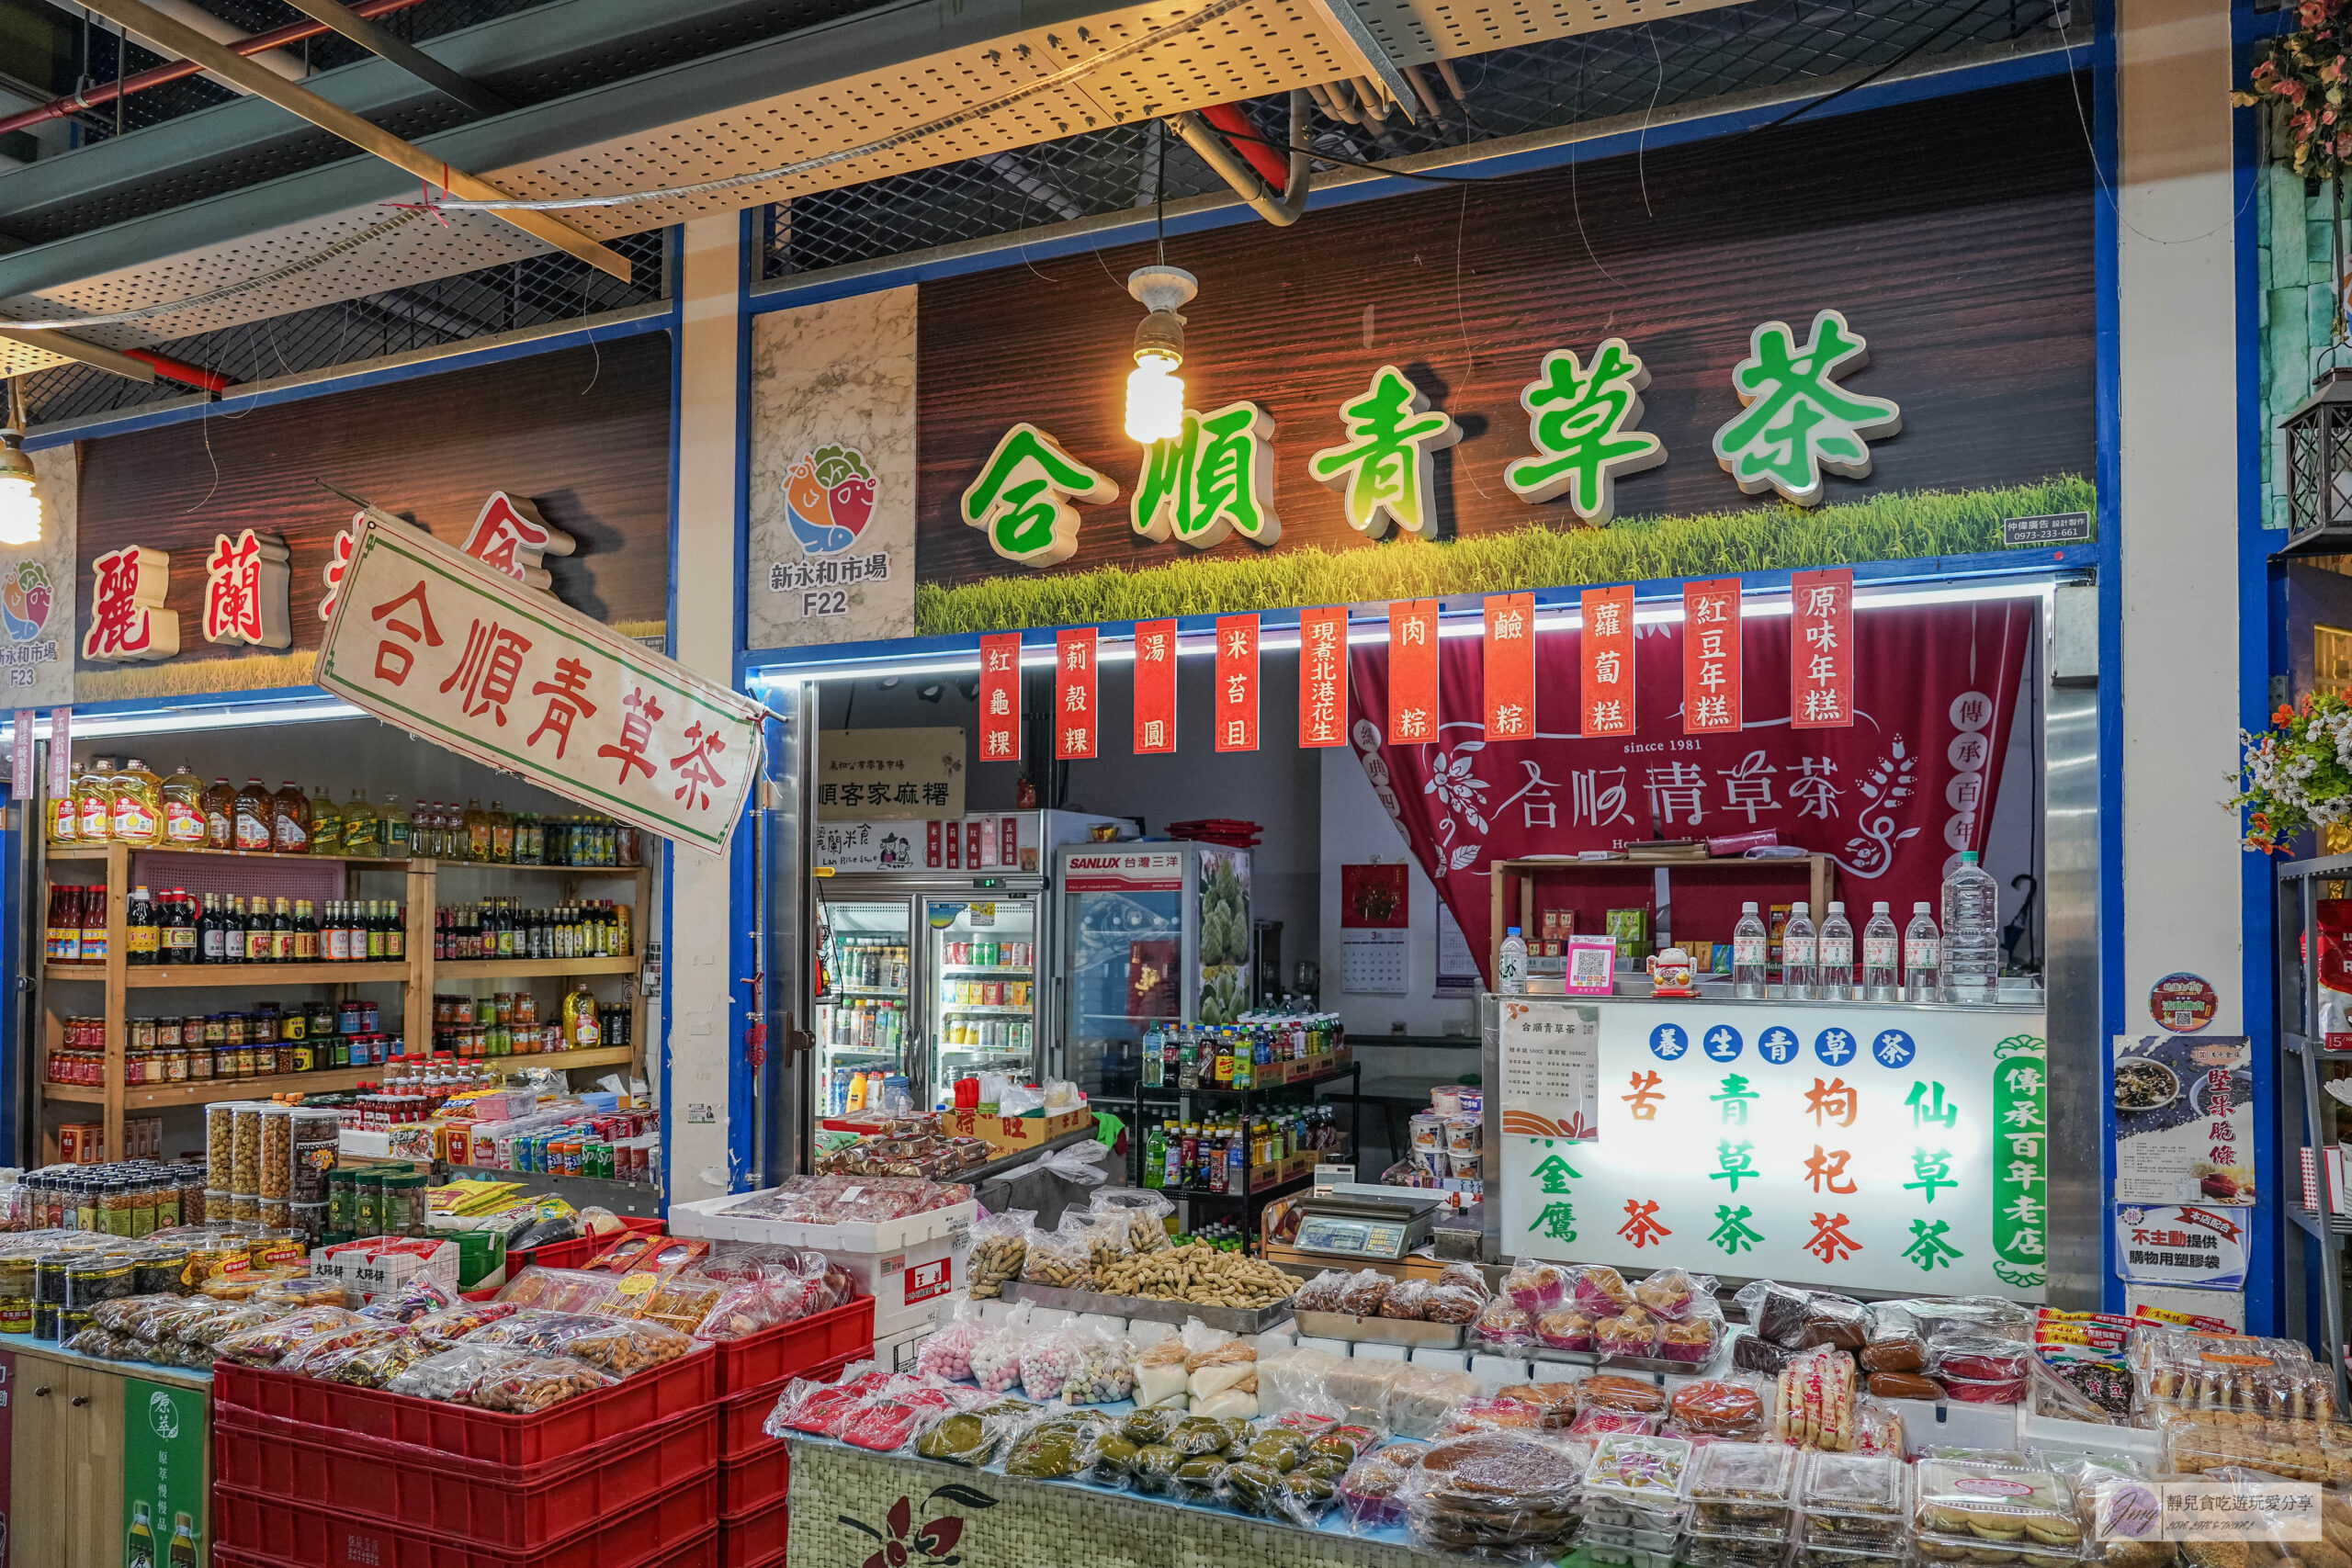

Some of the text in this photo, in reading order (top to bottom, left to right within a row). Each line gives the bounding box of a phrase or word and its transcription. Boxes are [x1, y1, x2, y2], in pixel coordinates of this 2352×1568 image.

[966, 315, 1894, 557] 合順青草茶
[2007, 518, 2085, 531] 仲偉廣告 設計製作
[2014, 528, 2078, 540] 0973-233-661
[771, 556, 888, 590] 新永和市場
[802, 591, 846, 615] F22
[11, 670, 34, 687] F23
[1143, 634, 1165, 749] 湯圓
[1225, 629, 1248, 746] 米苔目
[1310, 621, 1337, 742] 現煮北港花生
[1400, 615, 1427, 739] 肉粽
[1494, 609, 1523, 735] 鹼粽
[1591, 603, 1623, 732] 蘿蔔糕
[1695, 595, 1730, 728] 紅豆年糕
[1804, 585, 1840, 722] 原味年糕
[371, 580, 726, 811] 合順青草茶
[989, 648, 1011, 757] 紅龜粿
[1669, 739, 1702, 751] 1981
[1490, 750, 1847, 829] 合順青草茶
[841, 856, 858, 864] Rice
[1069, 857, 1122, 870] SANLUX
[1124, 855, 1179, 868] 台灣三洋
[1521, 1021, 1576, 1034] 合順青草茶
[1657, 1028, 1912, 1066] 養生青草茶
[298, 1142, 336, 1150] POPCORN
[2208, 1069, 2236, 1167] 堅果脆條
[1527, 1138, 1583, 1244] 金鷹
[1617, 1070, 1672, 1248] 苦茶
[1706, 1073, 1766, 1256] 青草茶
[1803, 1077, 1864, 1265] 枸杞茶
[1900, 1081, 1964, 1272] 仙草茶
[2001, 1066, 2045, 1257] 傳承百年老店
[2129, 1250, 2221, 1269] 購物用塑膠袋
[2132, 1228, 2219, 1249] 不主動提供
[2190, 1211, 2231, 1234] 本店配合
[315, 1262, 345, 1279] 太陽餅
[355, 1267, 385, 1284] 太陽餅
[154, 1393, 171, 1439] 原萃
[157, 1450, 168, 1531] 原萃慢慢品
